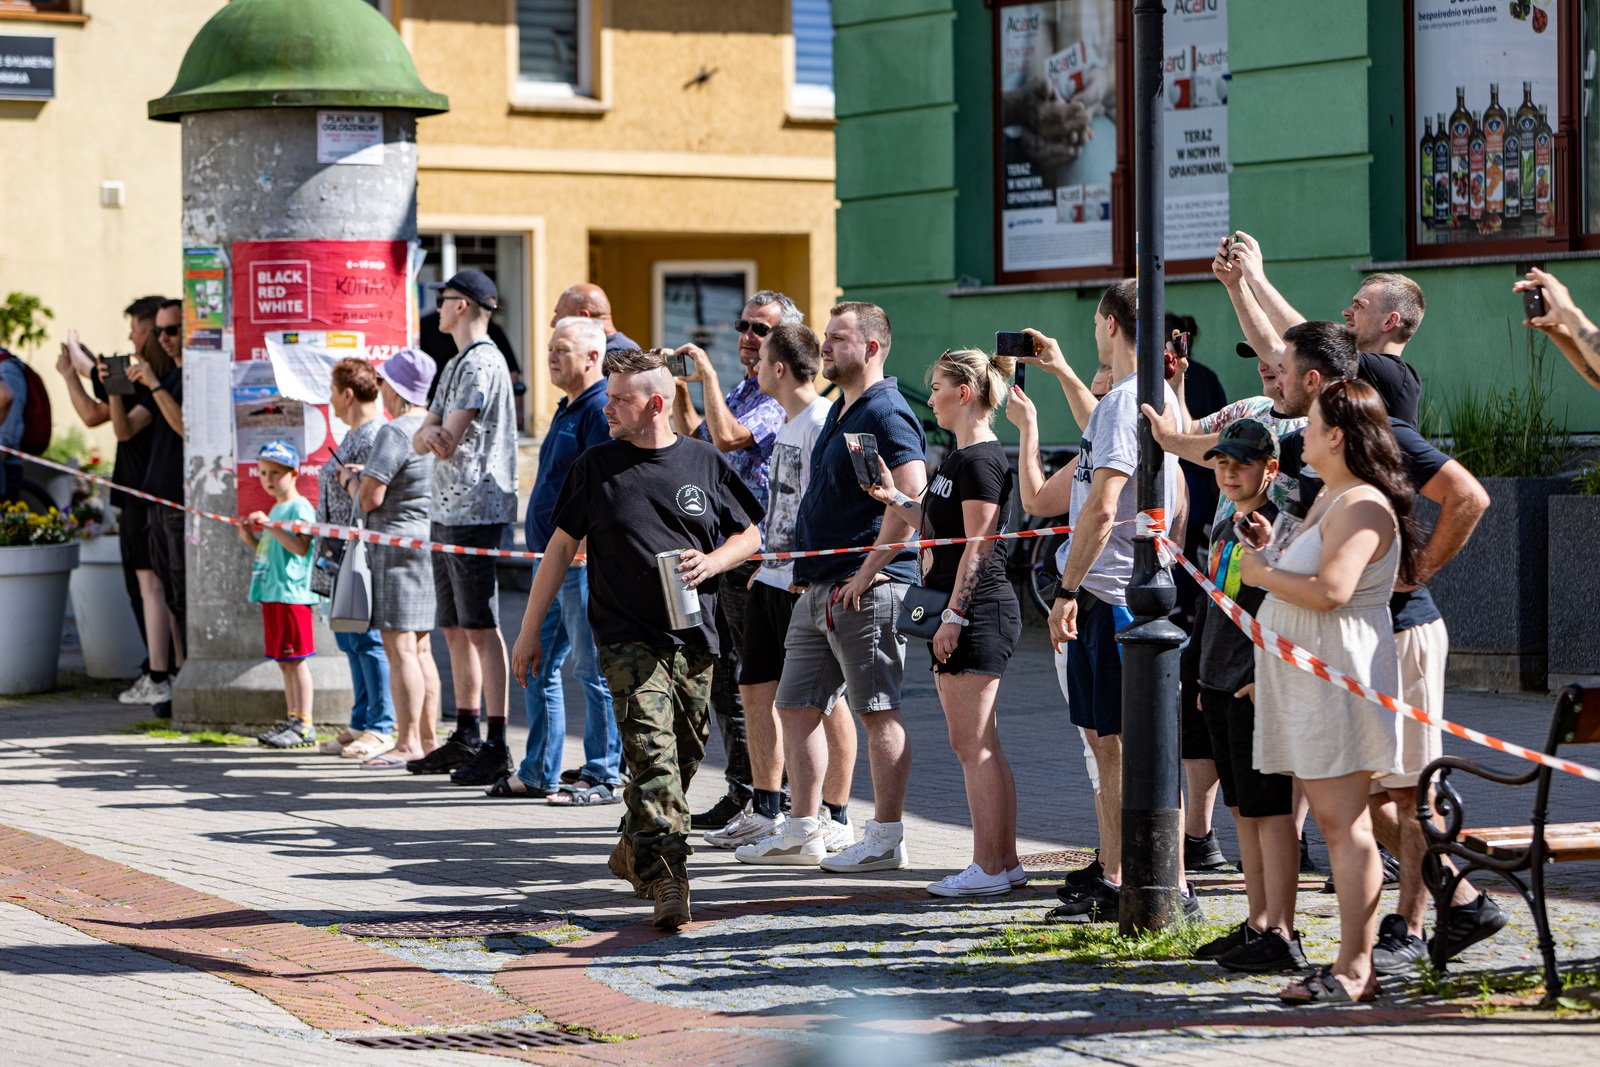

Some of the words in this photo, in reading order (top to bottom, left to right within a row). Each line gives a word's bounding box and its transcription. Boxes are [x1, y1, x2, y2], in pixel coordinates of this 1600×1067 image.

[1173, 0, 1217, 15] Acard
[1006, 14, 1039, 33] Acard
[1184, 129, 1212, 143] TERAZ
[1177, 149, 1185, 160] W
[1187, 145, 1220, 158] NOWYM
[257, 271, 303, 284] BLACK
[257, 287, 286, 299] RED
[257, 300, 303, 314] WHITE
